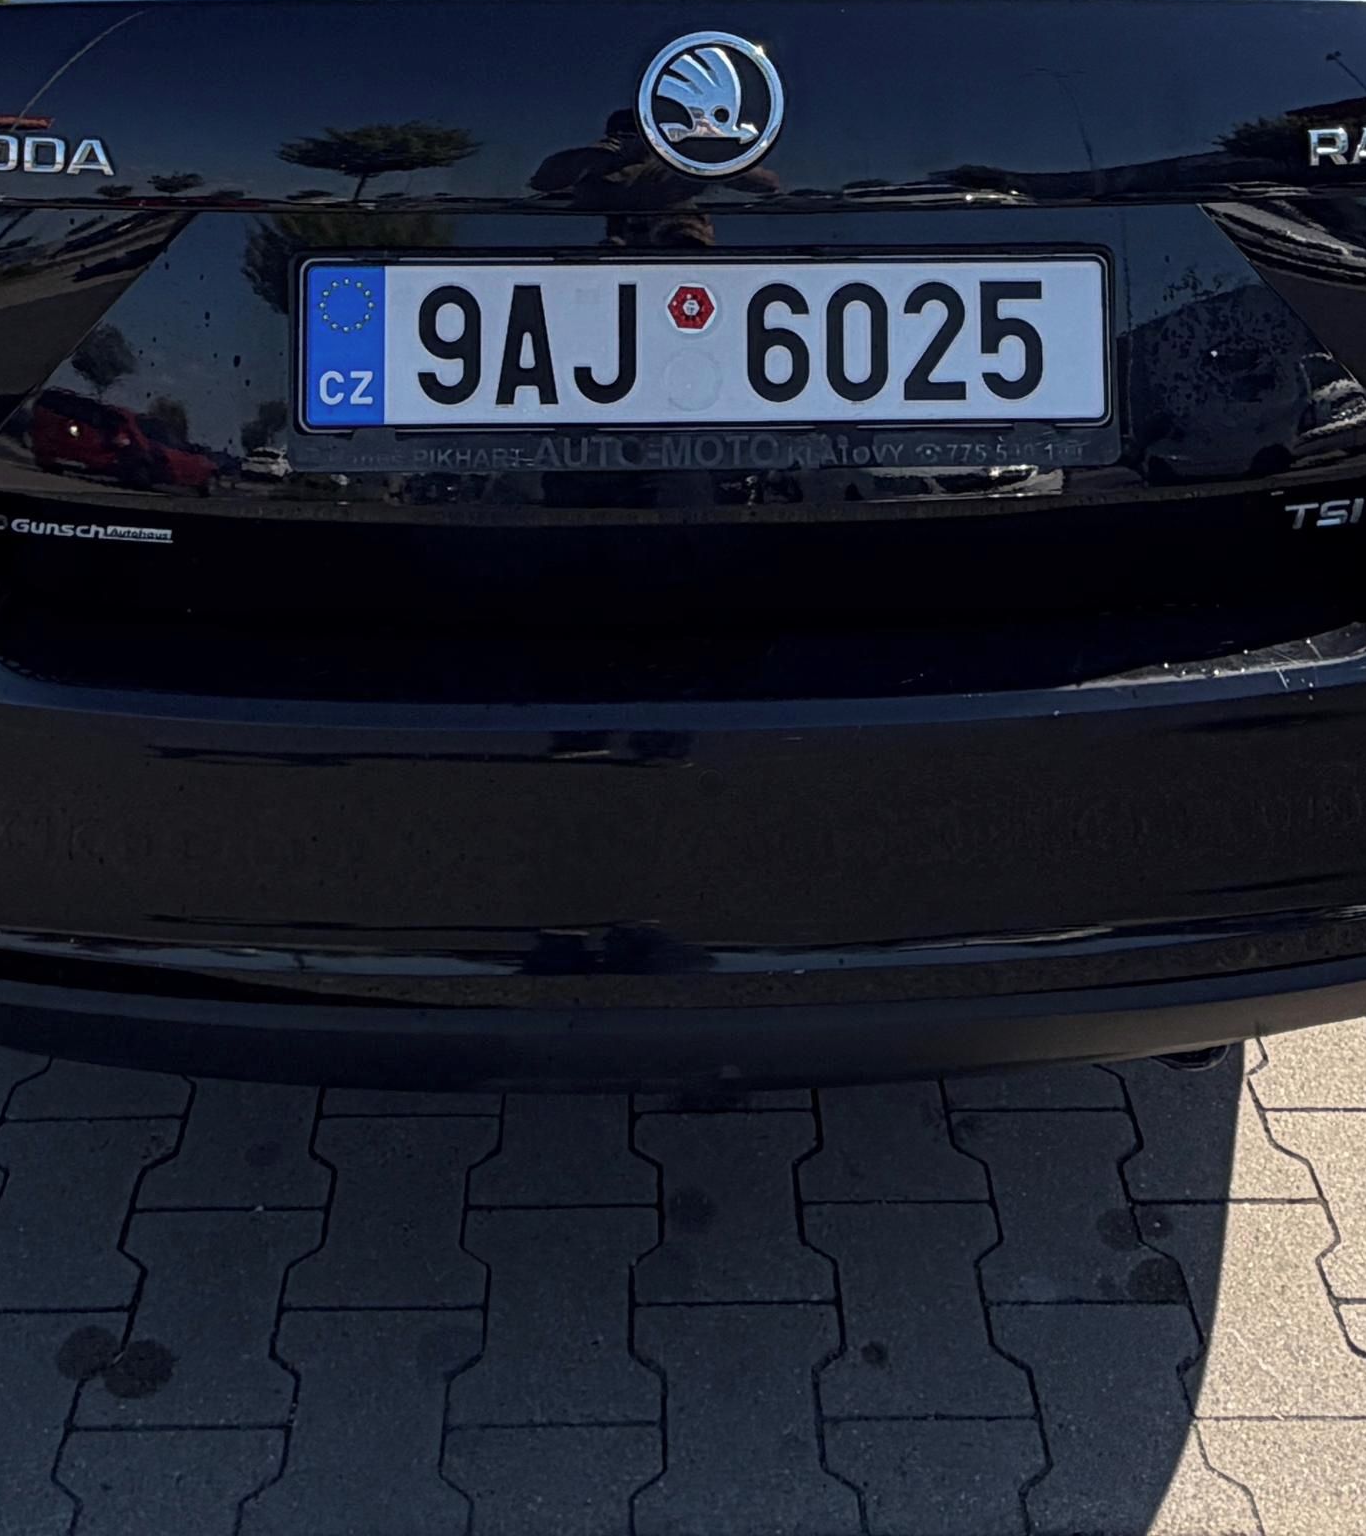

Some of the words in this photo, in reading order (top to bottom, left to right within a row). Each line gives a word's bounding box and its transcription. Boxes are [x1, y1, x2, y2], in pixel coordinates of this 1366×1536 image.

[319, 370, 374, 406] CZ
[417, 281, 637, 405] 9AJ
[746, 279, 1045, 403] 6025
[11, 518, 106, 540] Gunsch
[1285, 498, 1364, 529] TSI
